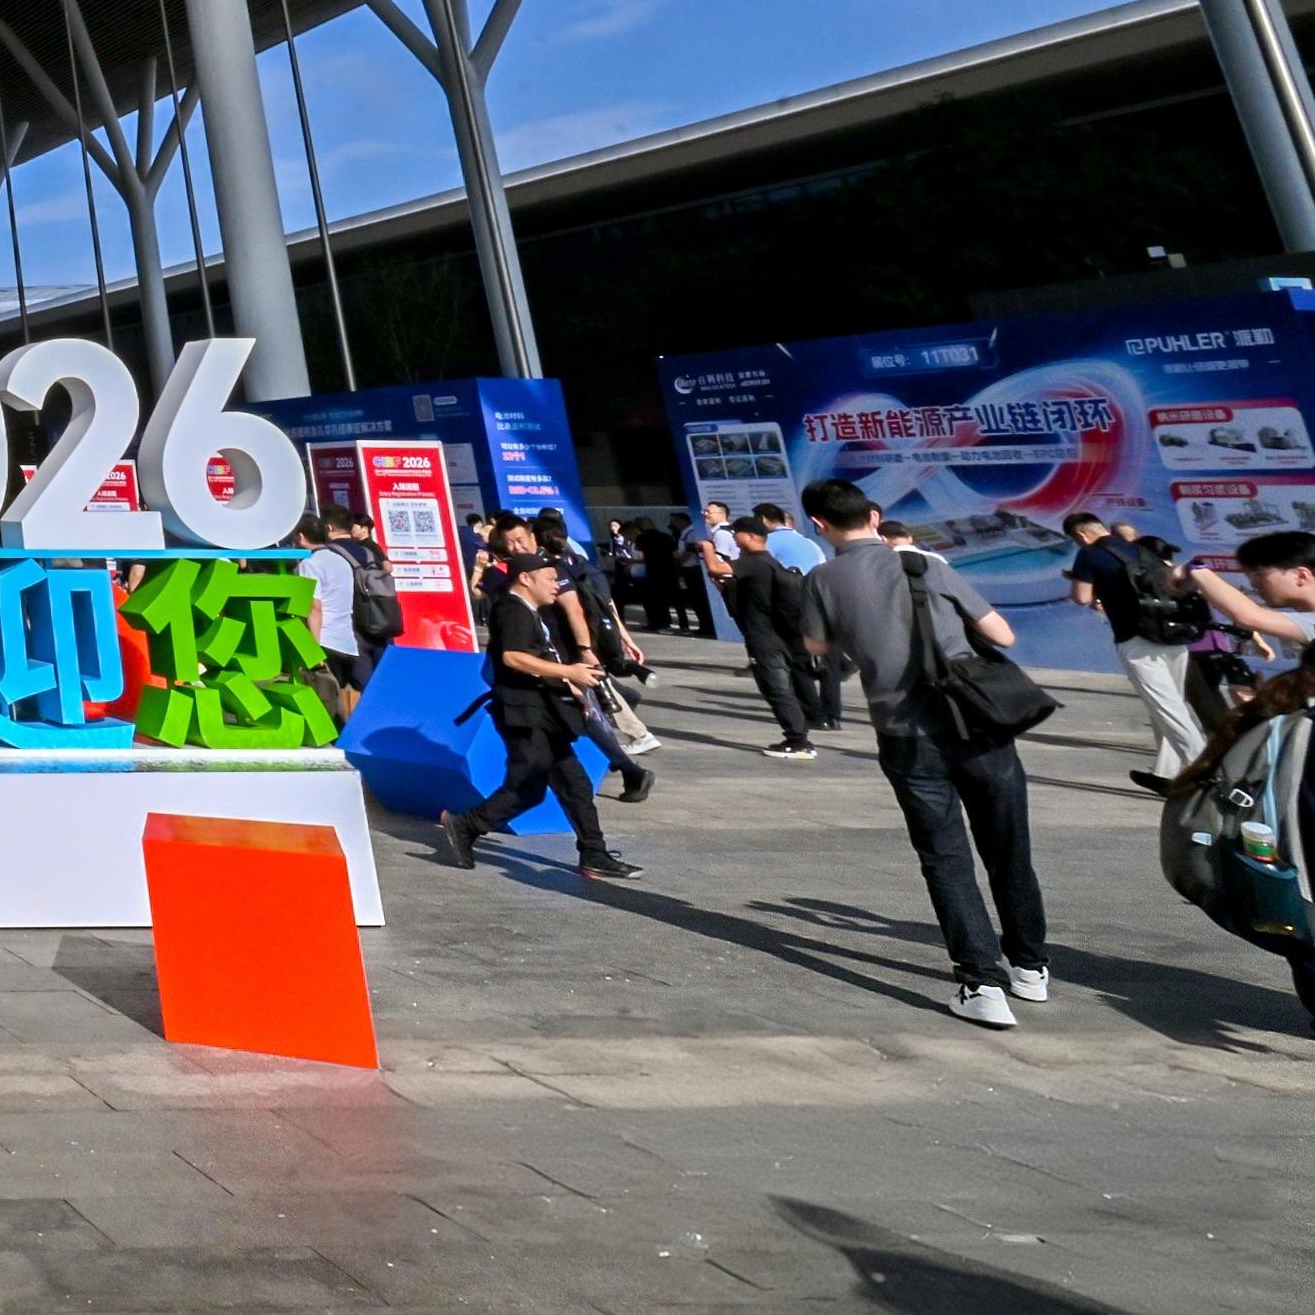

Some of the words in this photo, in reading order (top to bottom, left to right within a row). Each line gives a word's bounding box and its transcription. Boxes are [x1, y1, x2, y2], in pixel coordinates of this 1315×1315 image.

[803, 399, 1116, 443] 打造新能源产业链闭环
[402, 456, 432, 469] 2026
